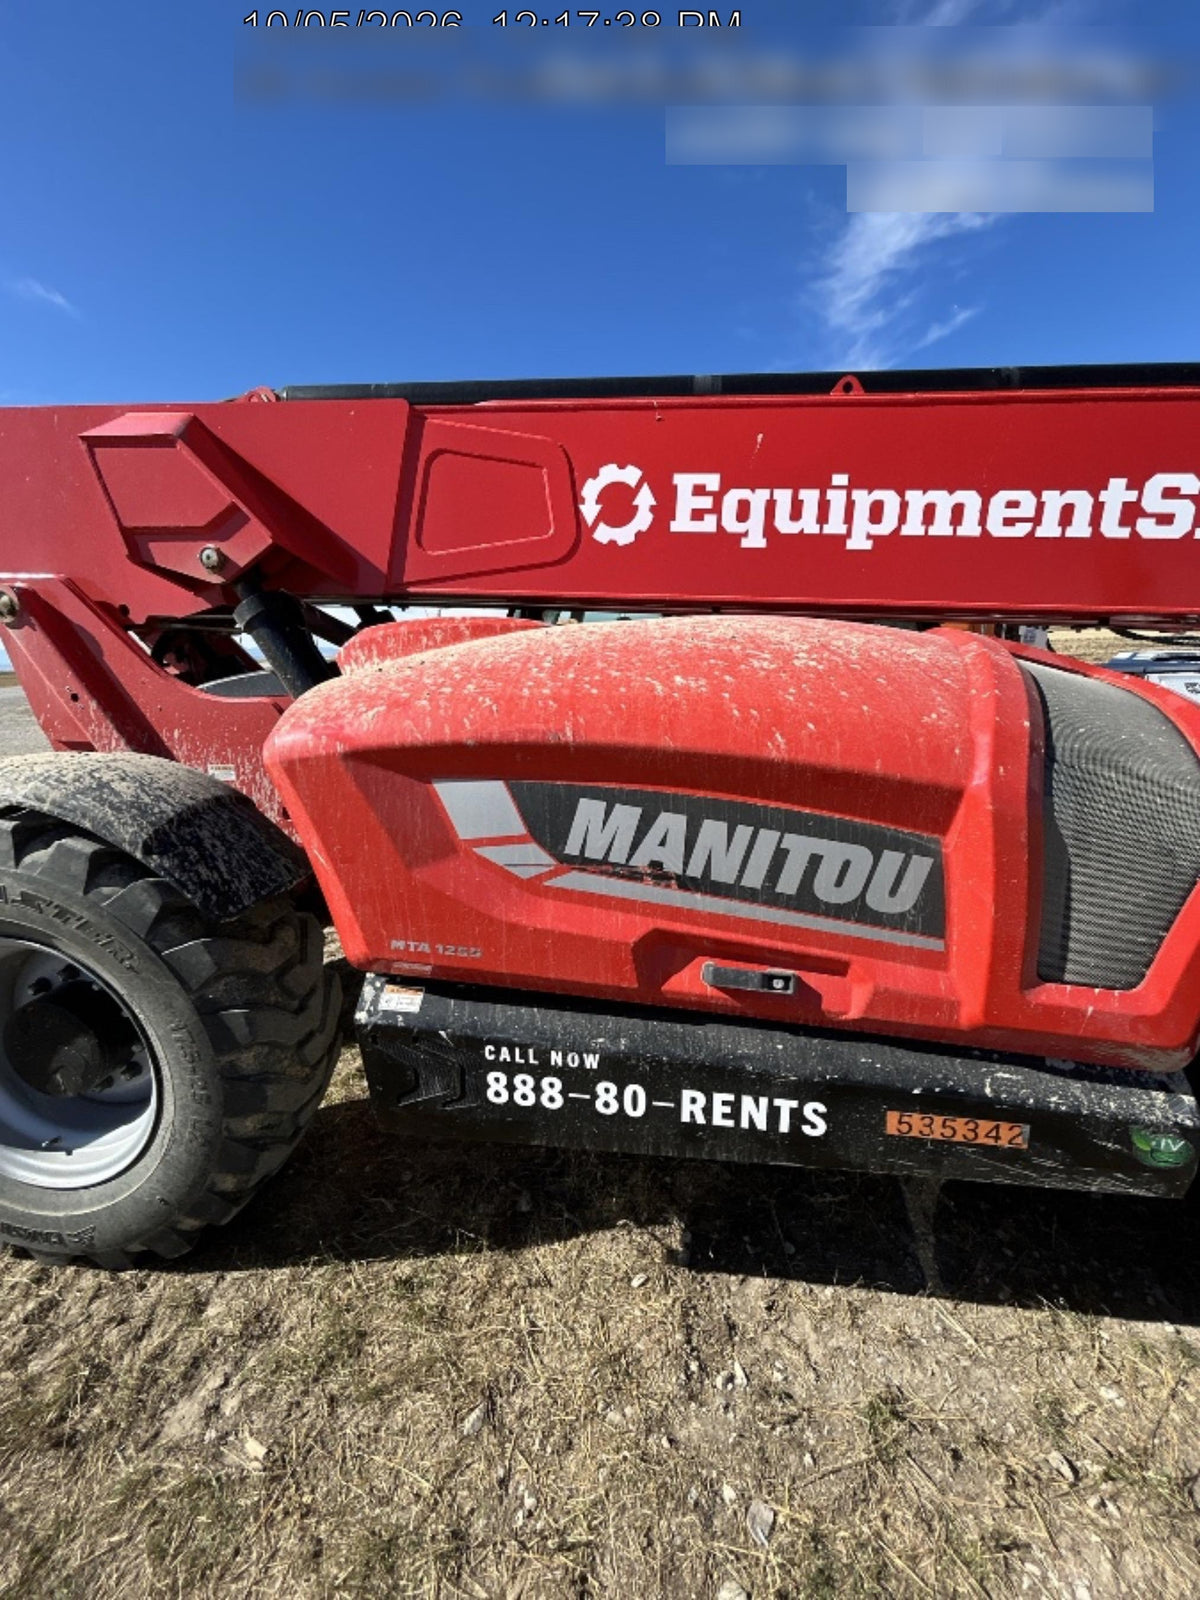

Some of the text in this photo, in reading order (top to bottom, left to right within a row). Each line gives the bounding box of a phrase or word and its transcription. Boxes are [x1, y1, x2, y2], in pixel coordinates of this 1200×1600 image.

[670, 472, 1200, 550] EquipmentS
[563, 797, 934, 914] MANITOU
[390, 939, 430, 953] MTA
[484, 1045, 600, 1070] CALL NOW
[486, 1071, 828, 1137] 888-80-RENTS
[896, 1113, 1024, 1146] 535342
